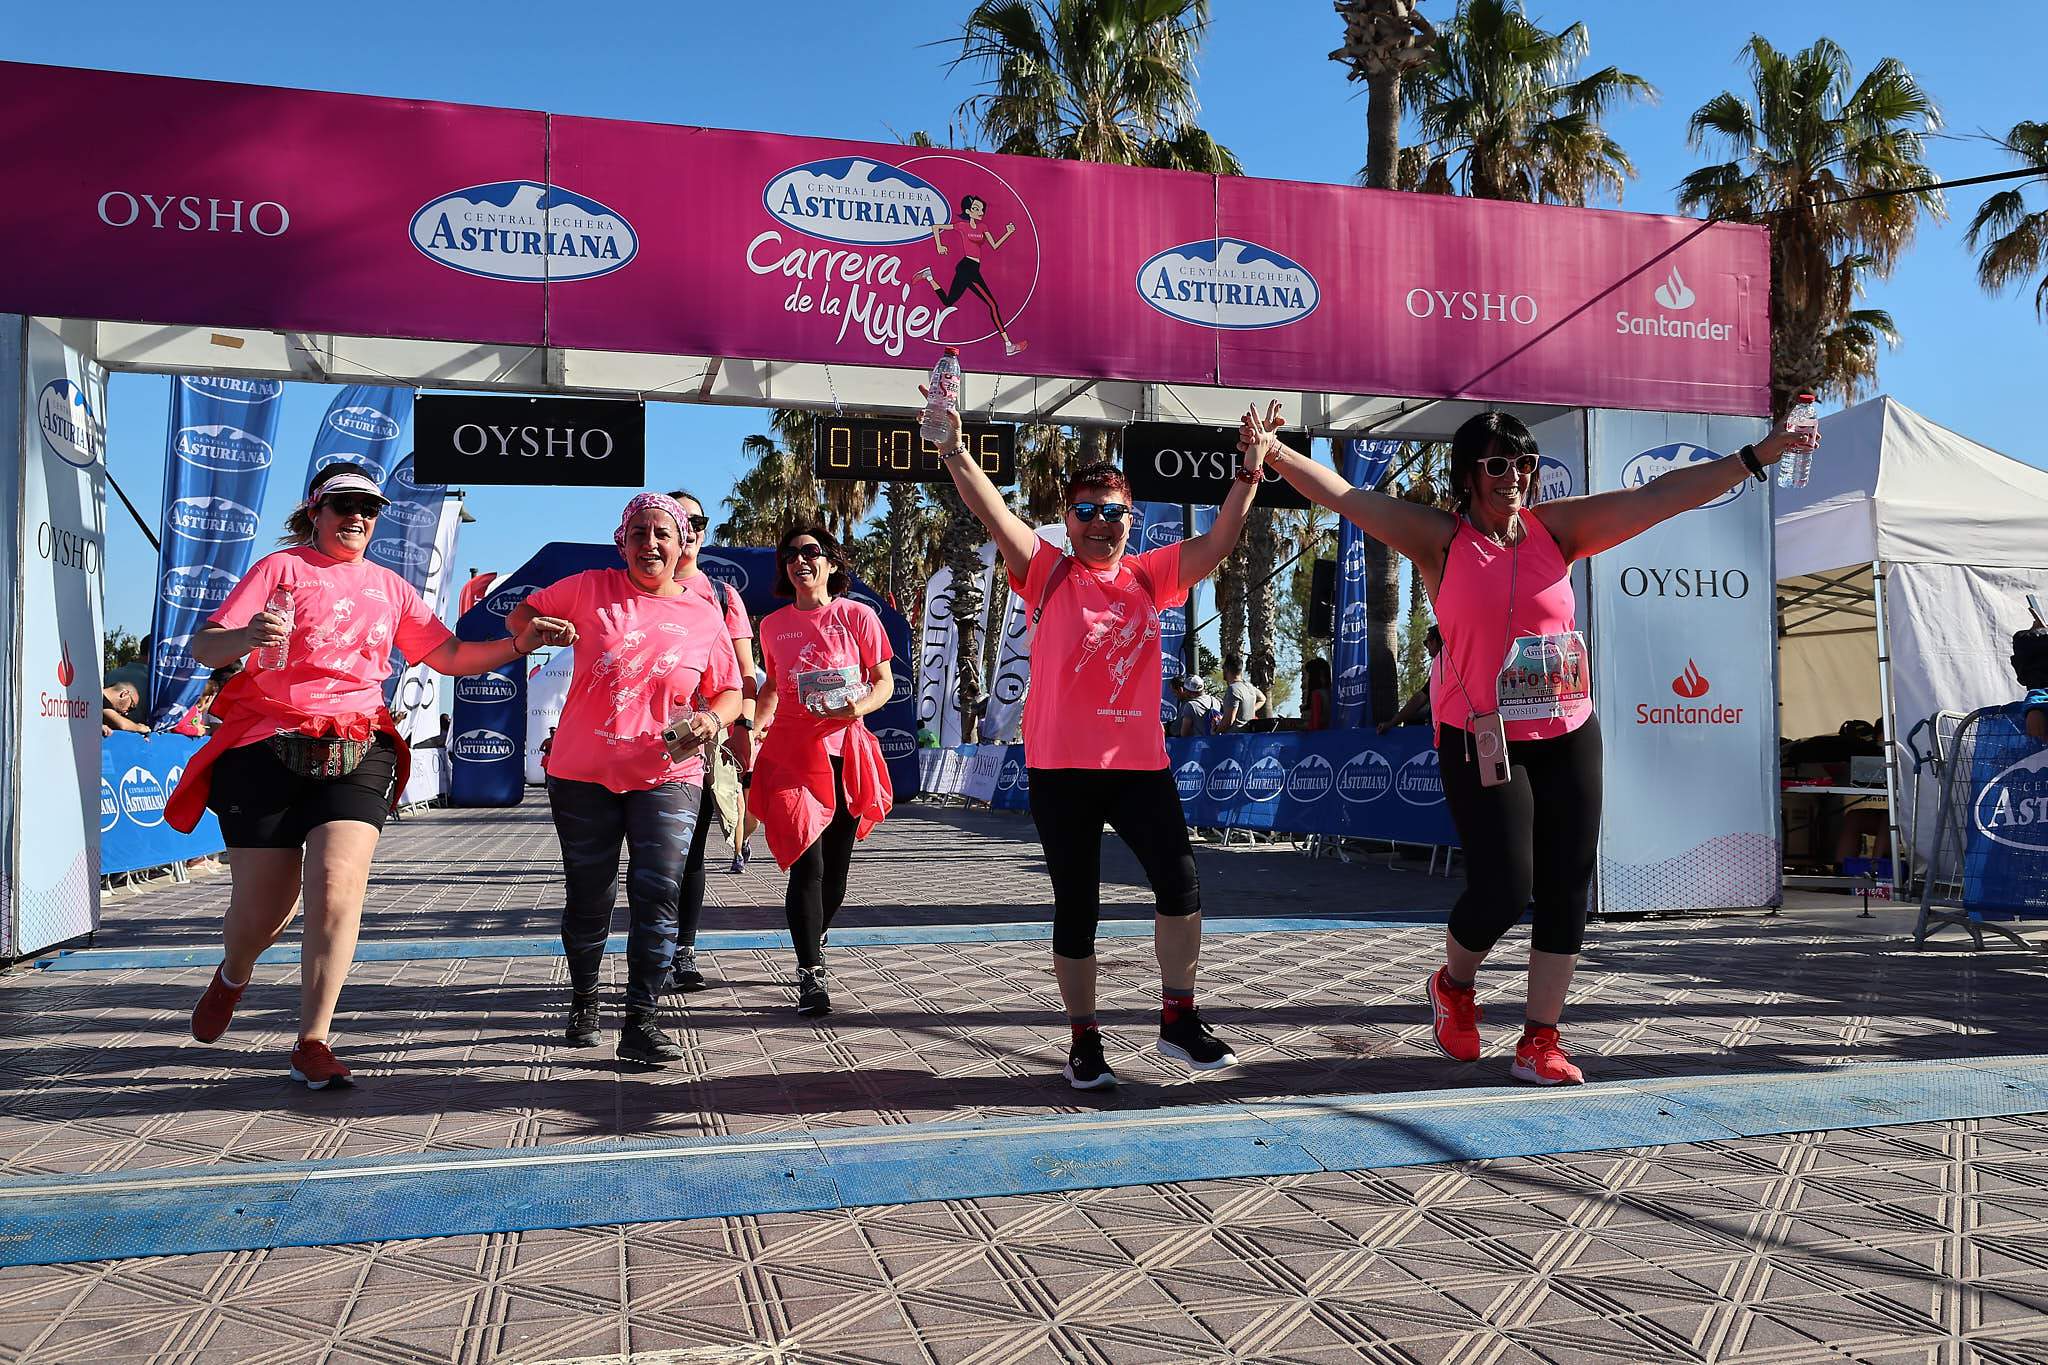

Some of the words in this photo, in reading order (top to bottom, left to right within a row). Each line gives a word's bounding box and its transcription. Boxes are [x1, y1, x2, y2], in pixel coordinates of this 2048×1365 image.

[778, 182, 936, 227] ASTURIANA
[808, 183, 866, 196] CENTRAL
[872, 189, 931, 202] LECHERA
[97, 191, 290, 236] OYSHO
[465, 212, 536, 226] CENTRAL
[428, 211, 622, 260] ASTURIANA
[746, 230, 902, 287] Carrera
[1151, 265, 1306, 310] ASTURIANA
[1179, 265, 1236, 279] CENTRAL
[1241, 271, 1300, 283] LECHERA
[784, 281, 813, 313] de
[819, 283, 841, 316] la
[835, 283, 958, 357] Mujer
[1406, 287, 1538, 325] OYSHO
[1616, 310, 1733, 341] Santander
[335, 415, 393, 437] ASTURIANA
[177, 434, 266, 464] ASTURIANA
[453, 424, 613, 460] OYSHO
[173, 506, 254, 535] ASTURIANA
[38, 521, 97, 575] OYSHO
[373, 543, 424, 561] ASTURIANA
[1620, 567, 1749, 599] OYSHO
[777, 631, 803, 640] OYSHO
[458, 683, 513, 696] ASTURIANA
[40, 691, 90, 720] Santander
[1636, 704, 1743, 724] Santander
[456, 741, 510, 754] ASTURIANA
[1289, 772, 1328, 790] ASTURIANA
[1339, 770, 1387, 790] ASTURIANA
